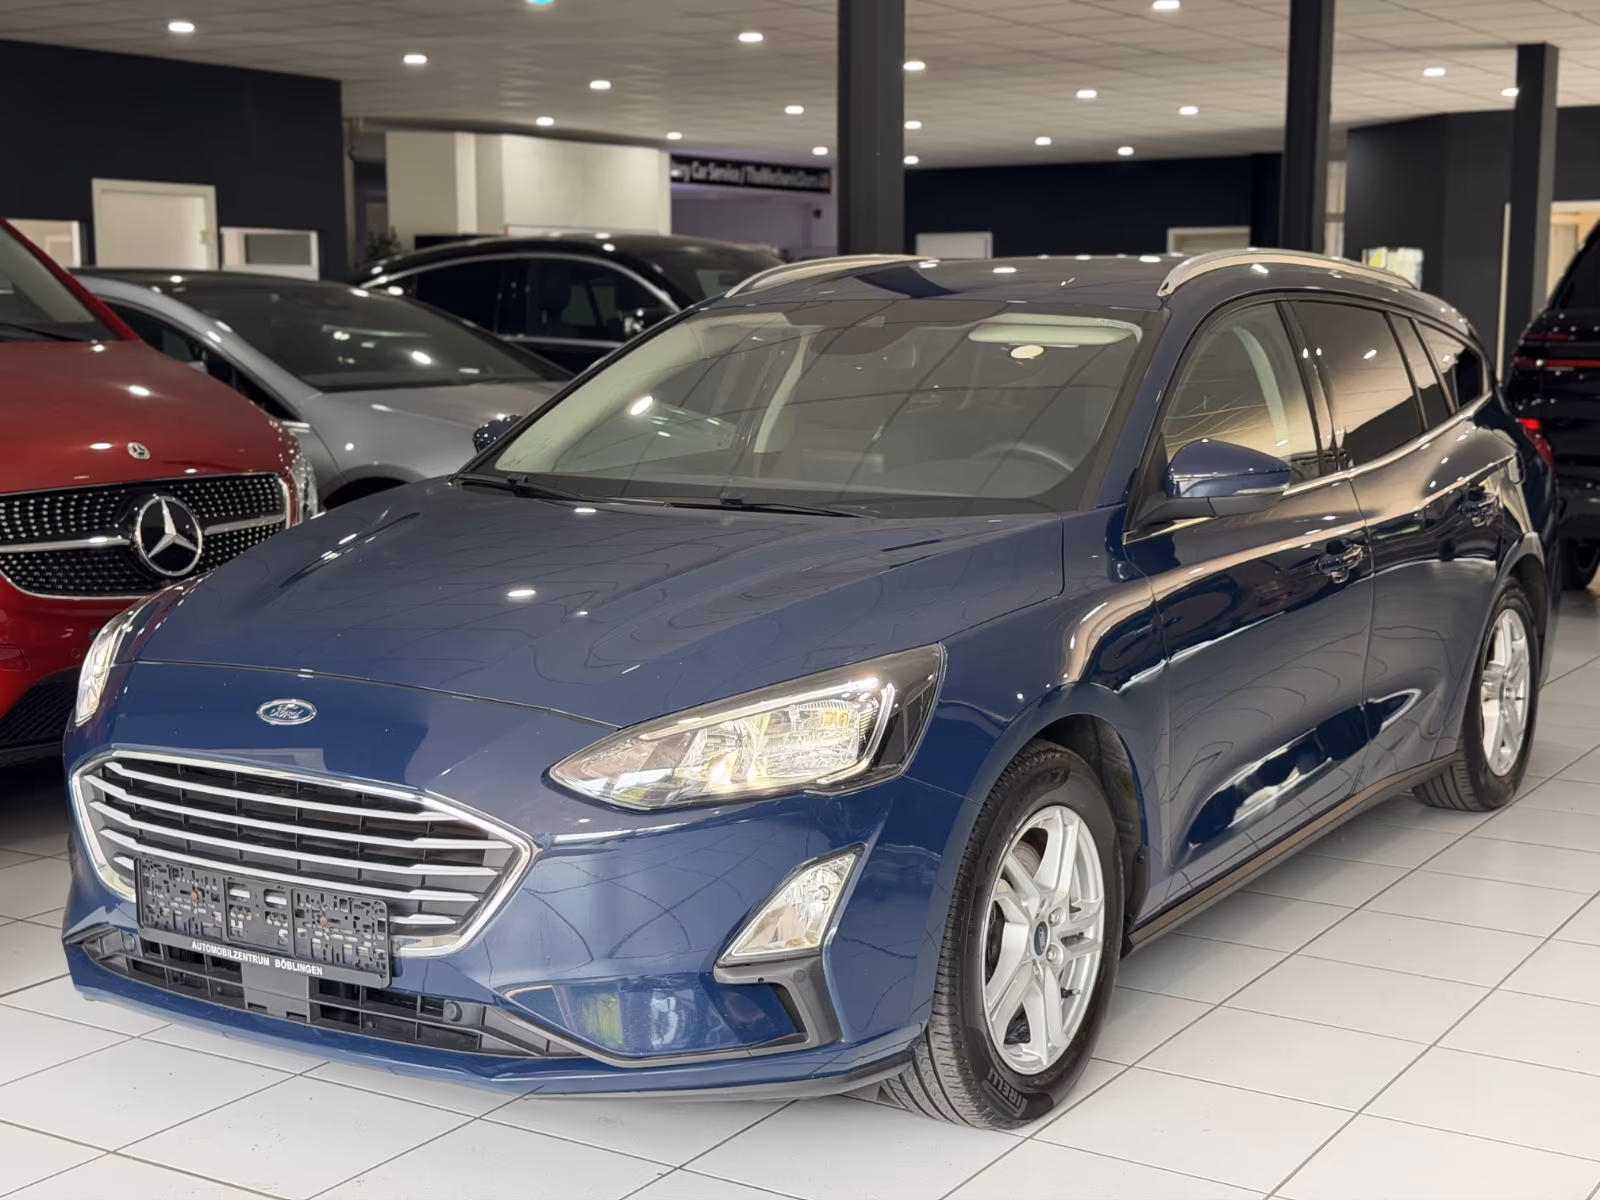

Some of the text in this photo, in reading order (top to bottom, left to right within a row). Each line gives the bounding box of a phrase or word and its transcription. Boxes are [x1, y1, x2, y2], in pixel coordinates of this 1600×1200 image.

[692, 161, 708, 180] Car
[709, 163, 739, 183] Service
[191, 940, 323, 976] AUTOMOBILZENTRUM BÖBLINGEN
[982, 1067, 1028, 1118] PIRELLI
